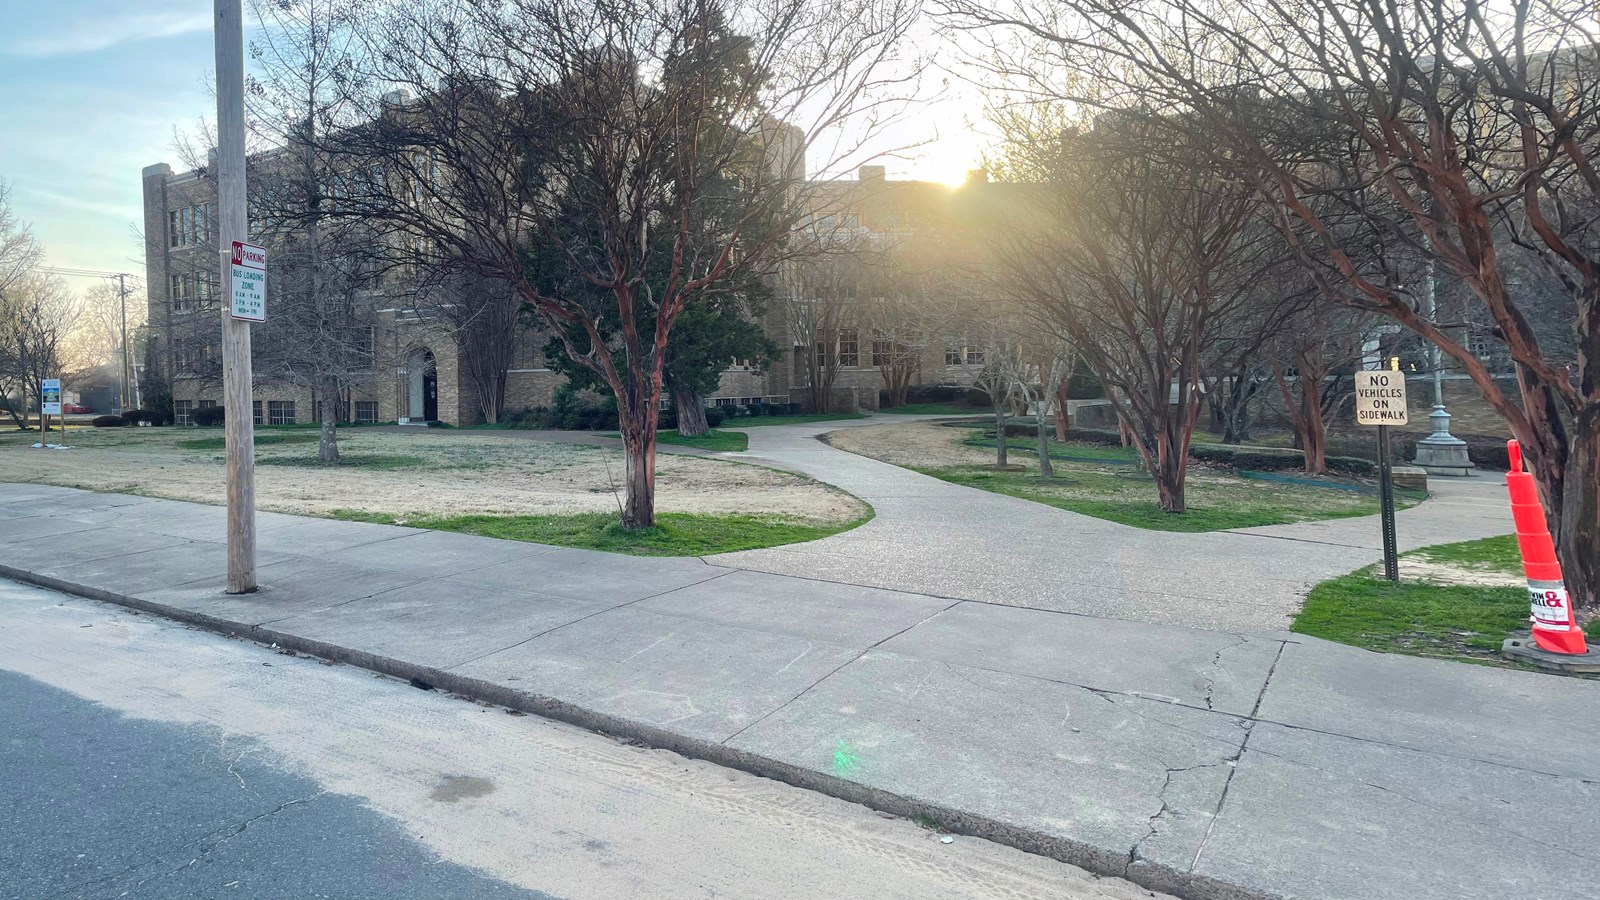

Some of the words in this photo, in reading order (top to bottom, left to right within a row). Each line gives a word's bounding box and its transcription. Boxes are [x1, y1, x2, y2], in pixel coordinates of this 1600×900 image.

[232, 246, 241, 261] NO
[243, 251, 264, 264] PARKING
[233, 269, 242, 278] BUS
[244, 272, 263, 281] LOADING
[242, 281, 254, 291] ZONE
[1370, 376, 1389, 386] NO
[1358, 389, 1402, 398] VEHICLES
[1373, 400, 1389, 409] ON
[1360, 411, 1405, 420] SIDEWALK
